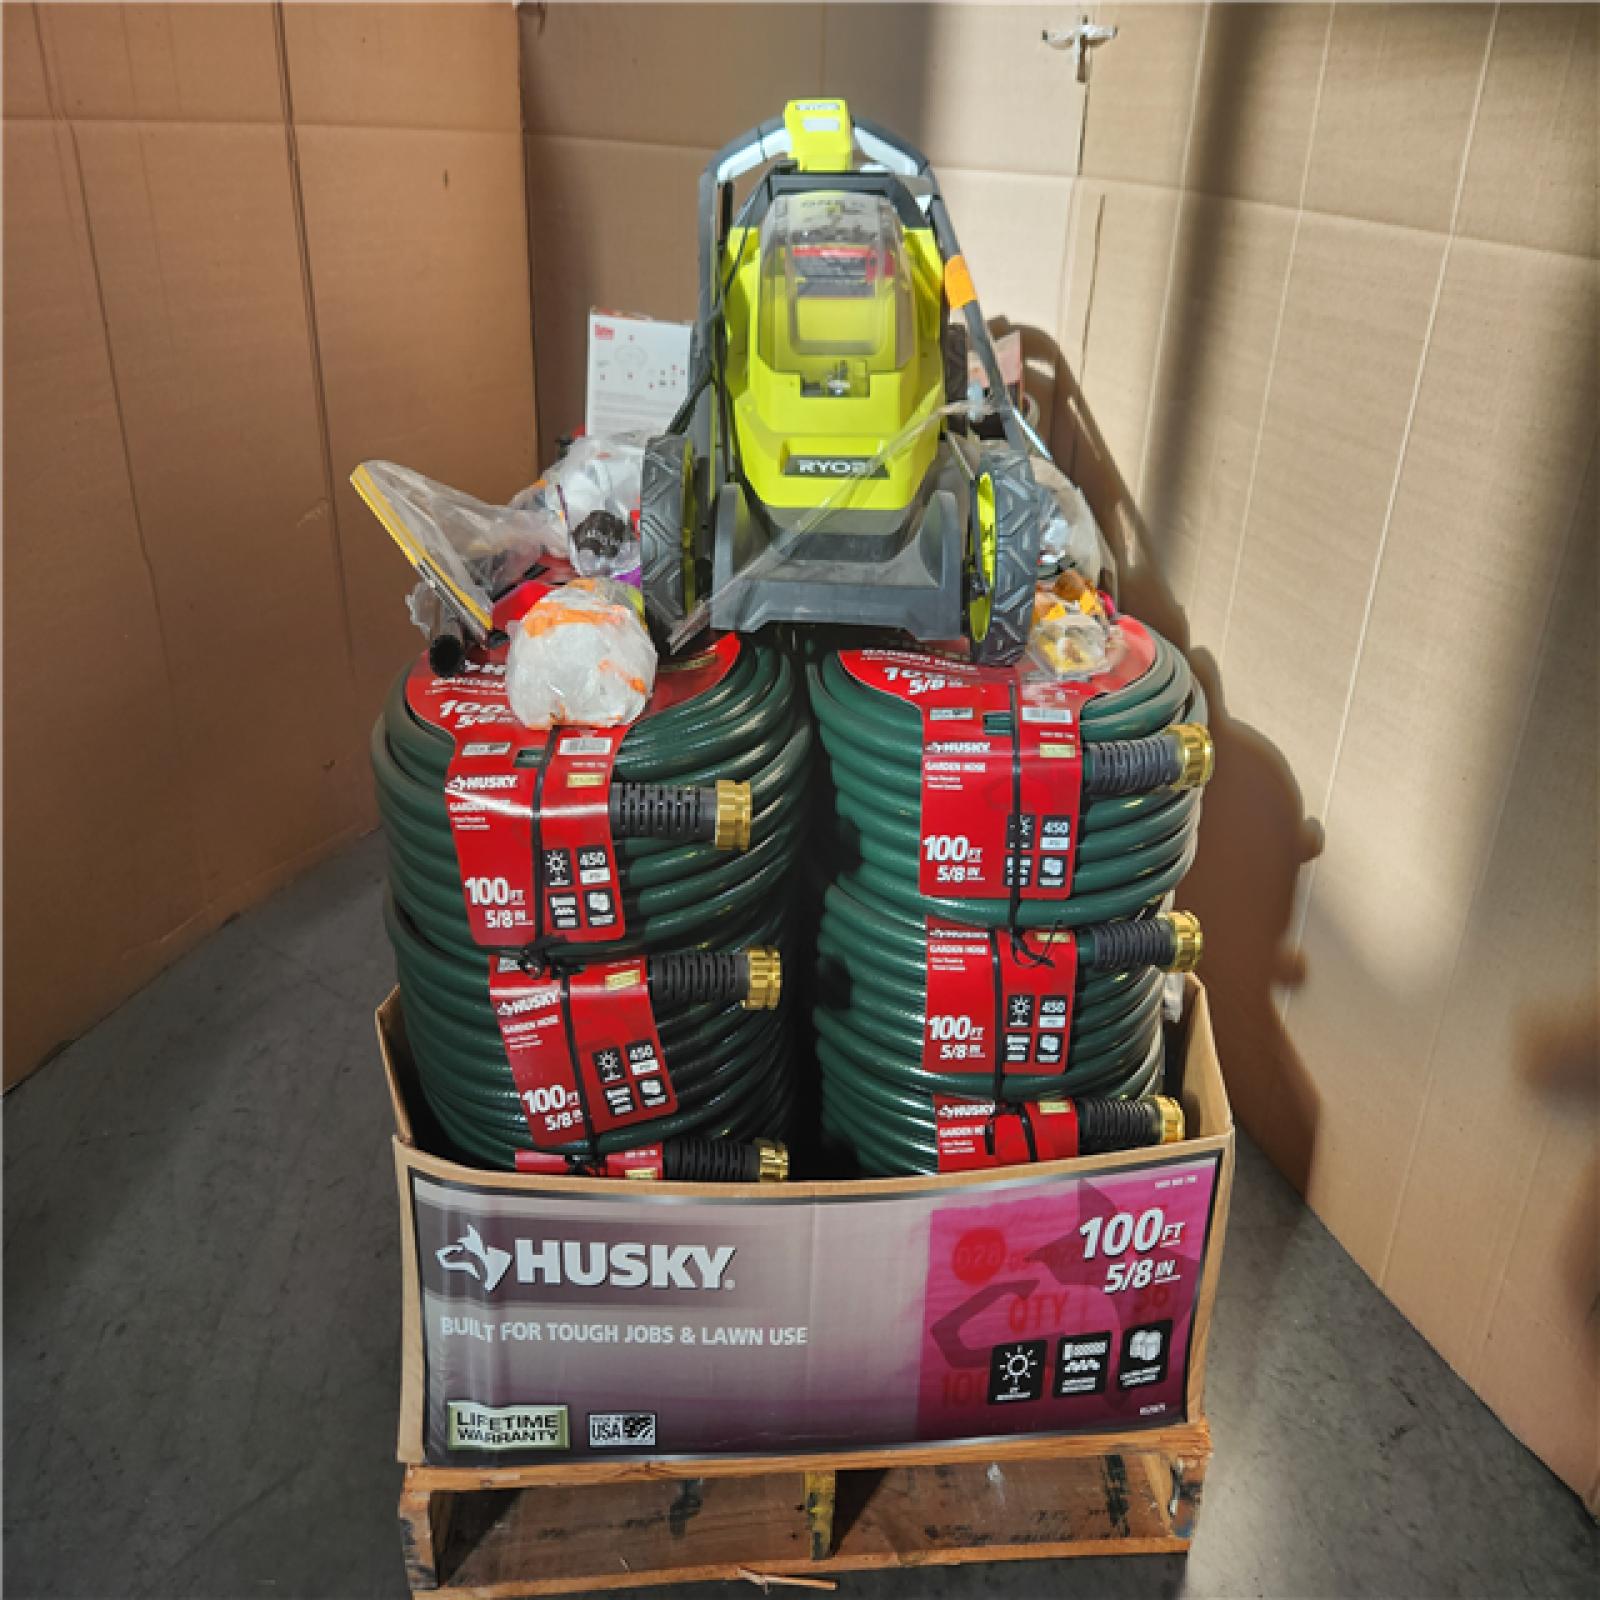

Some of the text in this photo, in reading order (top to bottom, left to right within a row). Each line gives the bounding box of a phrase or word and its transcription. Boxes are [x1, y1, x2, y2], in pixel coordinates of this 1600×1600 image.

[922, 835, 969, 861] 100
[937, 865, 966, 882] 5/8
[465, 877, 510, 906] 100
[485, 909, 513, 929] 5/8
[928, 1014, 971, 1041] 100
[940, 1044, 968, 1060] 5/8
[522, 1085, 566, 1115] 100
[544, 1111, 573, 1132] 5/8
[1079, 1208, 1164, 1260] 100
[515, 1238, 737, 1290] HUSKY
[1104, 1258, 1153, 1294] 5/8
[439, 1315, 809, 1347] BUILT FOR TOUGH JOBS & LAWN USE
[456, 1411, 559, 1431] LIFETIME
[592, 1421, 621, 1441] USA
